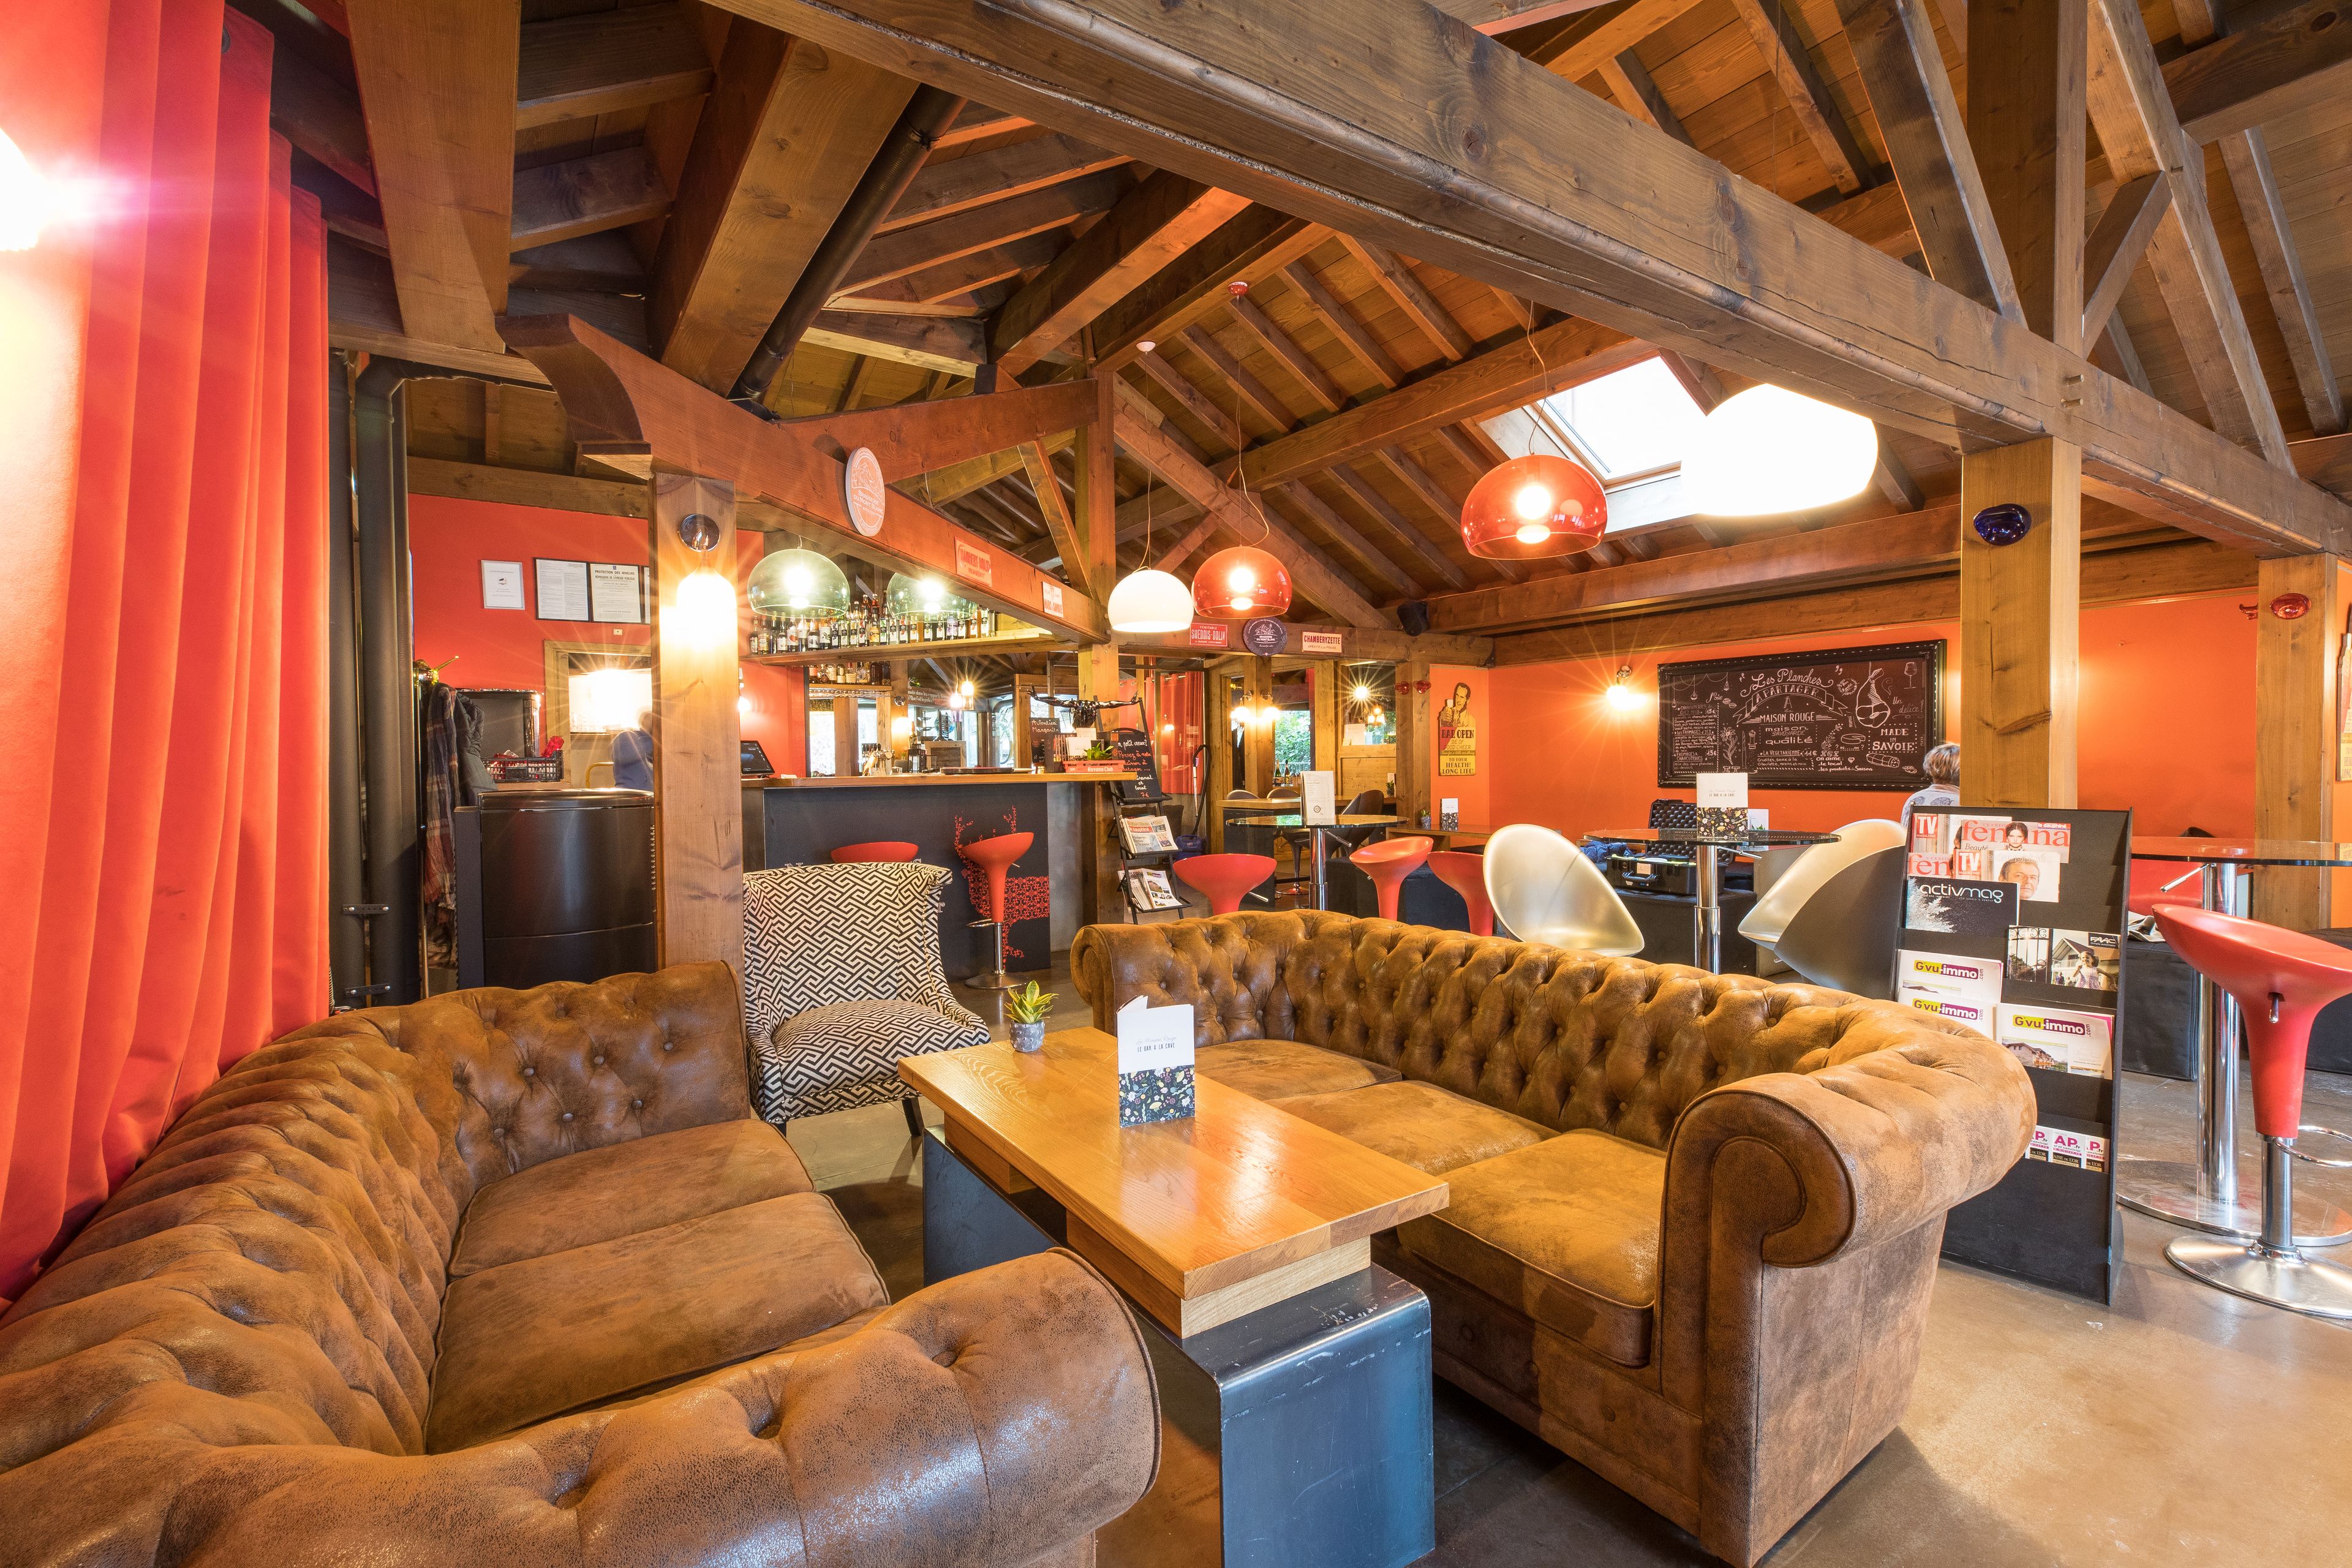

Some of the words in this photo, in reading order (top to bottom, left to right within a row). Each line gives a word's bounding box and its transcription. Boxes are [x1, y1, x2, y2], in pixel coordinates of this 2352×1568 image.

[1777, 668, 1827, 687] Planches
[1760, 714, 1787, 723] MAISON
[1790, 712, 1815, 722] ROUGE
[1442, 729, 1455, 738] BAR
[1457, 729, 1474, 739] OPEN
[1123, 739, 1133, 750] petit
[1765, 736, 1813, 745] qualité
[1872, 741, 1915, 751] SAVOIE
[1918, 816, 1937, 834] TV
[1959, 852, 1980, 871] TV
[1920, 883, 2004, 903] activmag
